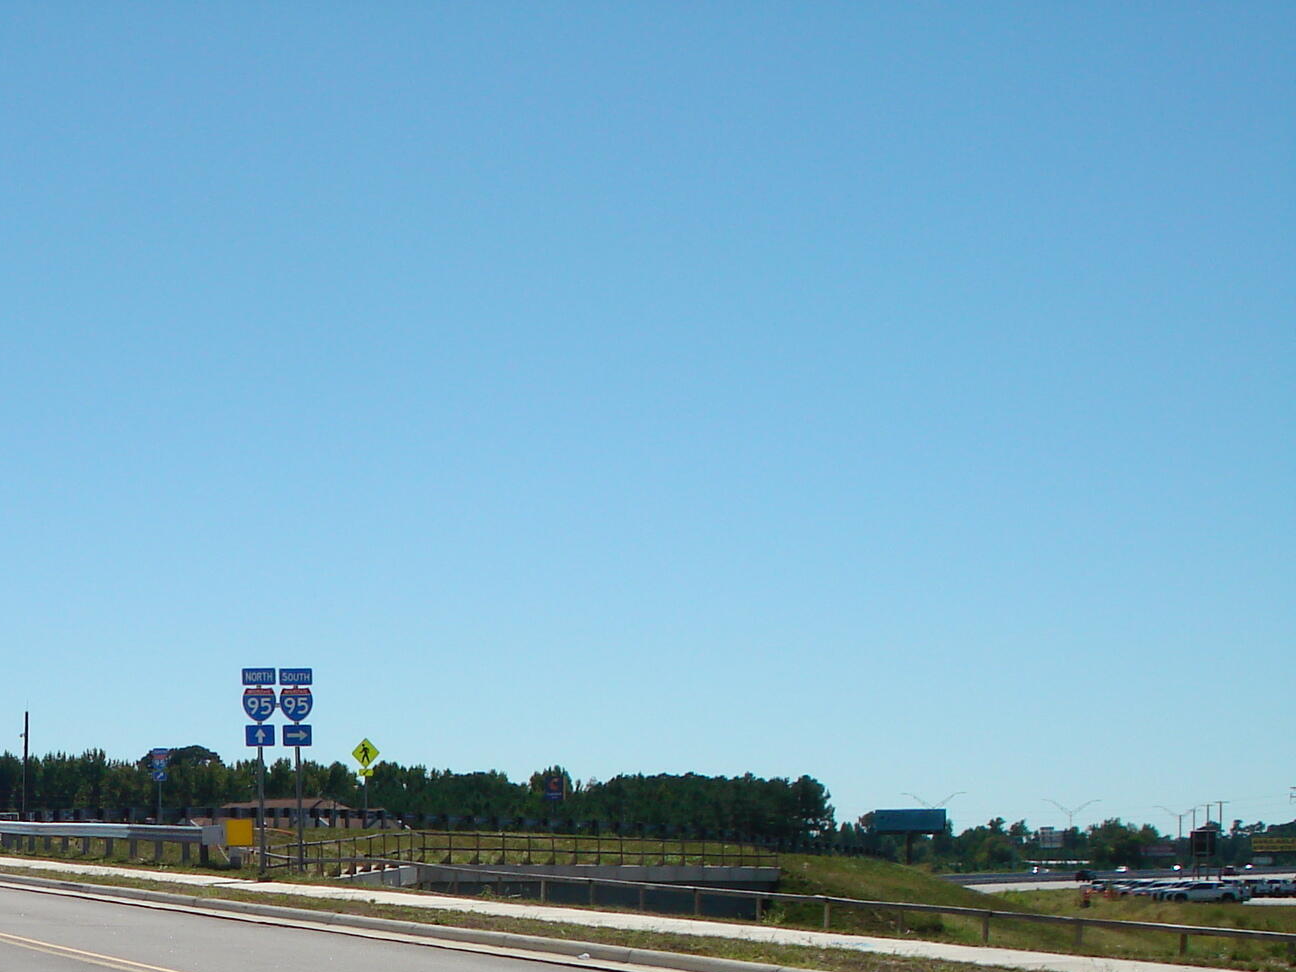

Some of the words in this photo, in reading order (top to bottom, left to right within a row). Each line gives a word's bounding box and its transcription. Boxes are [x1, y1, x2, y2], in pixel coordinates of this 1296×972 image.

[245, 671, 273, 682] NORTH
[281, 672, 310, 682] SOUTH
[247, 697, 272, 715] 95
[284, 697, 309, 715] 95
